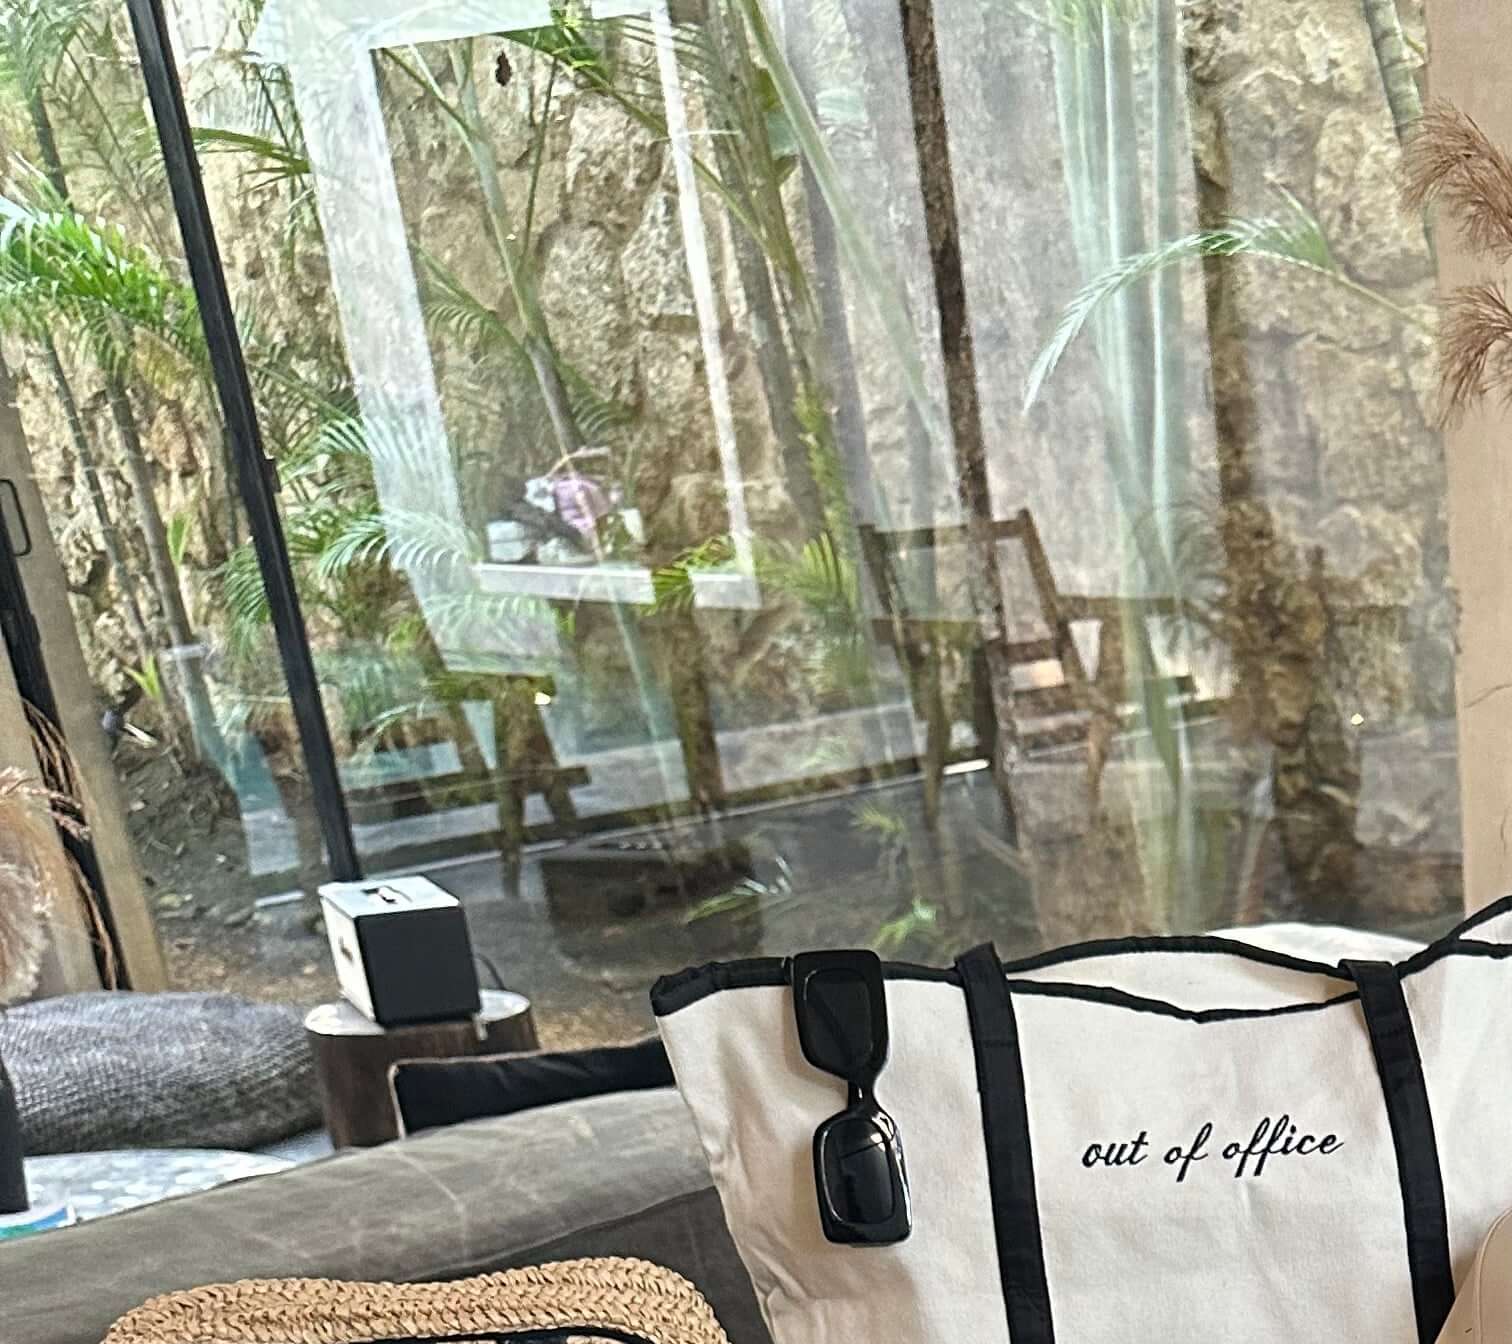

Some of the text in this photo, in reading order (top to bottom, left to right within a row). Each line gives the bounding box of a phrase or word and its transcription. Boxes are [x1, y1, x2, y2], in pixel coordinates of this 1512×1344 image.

[1081, 1113, 1345, 1184] out of office
